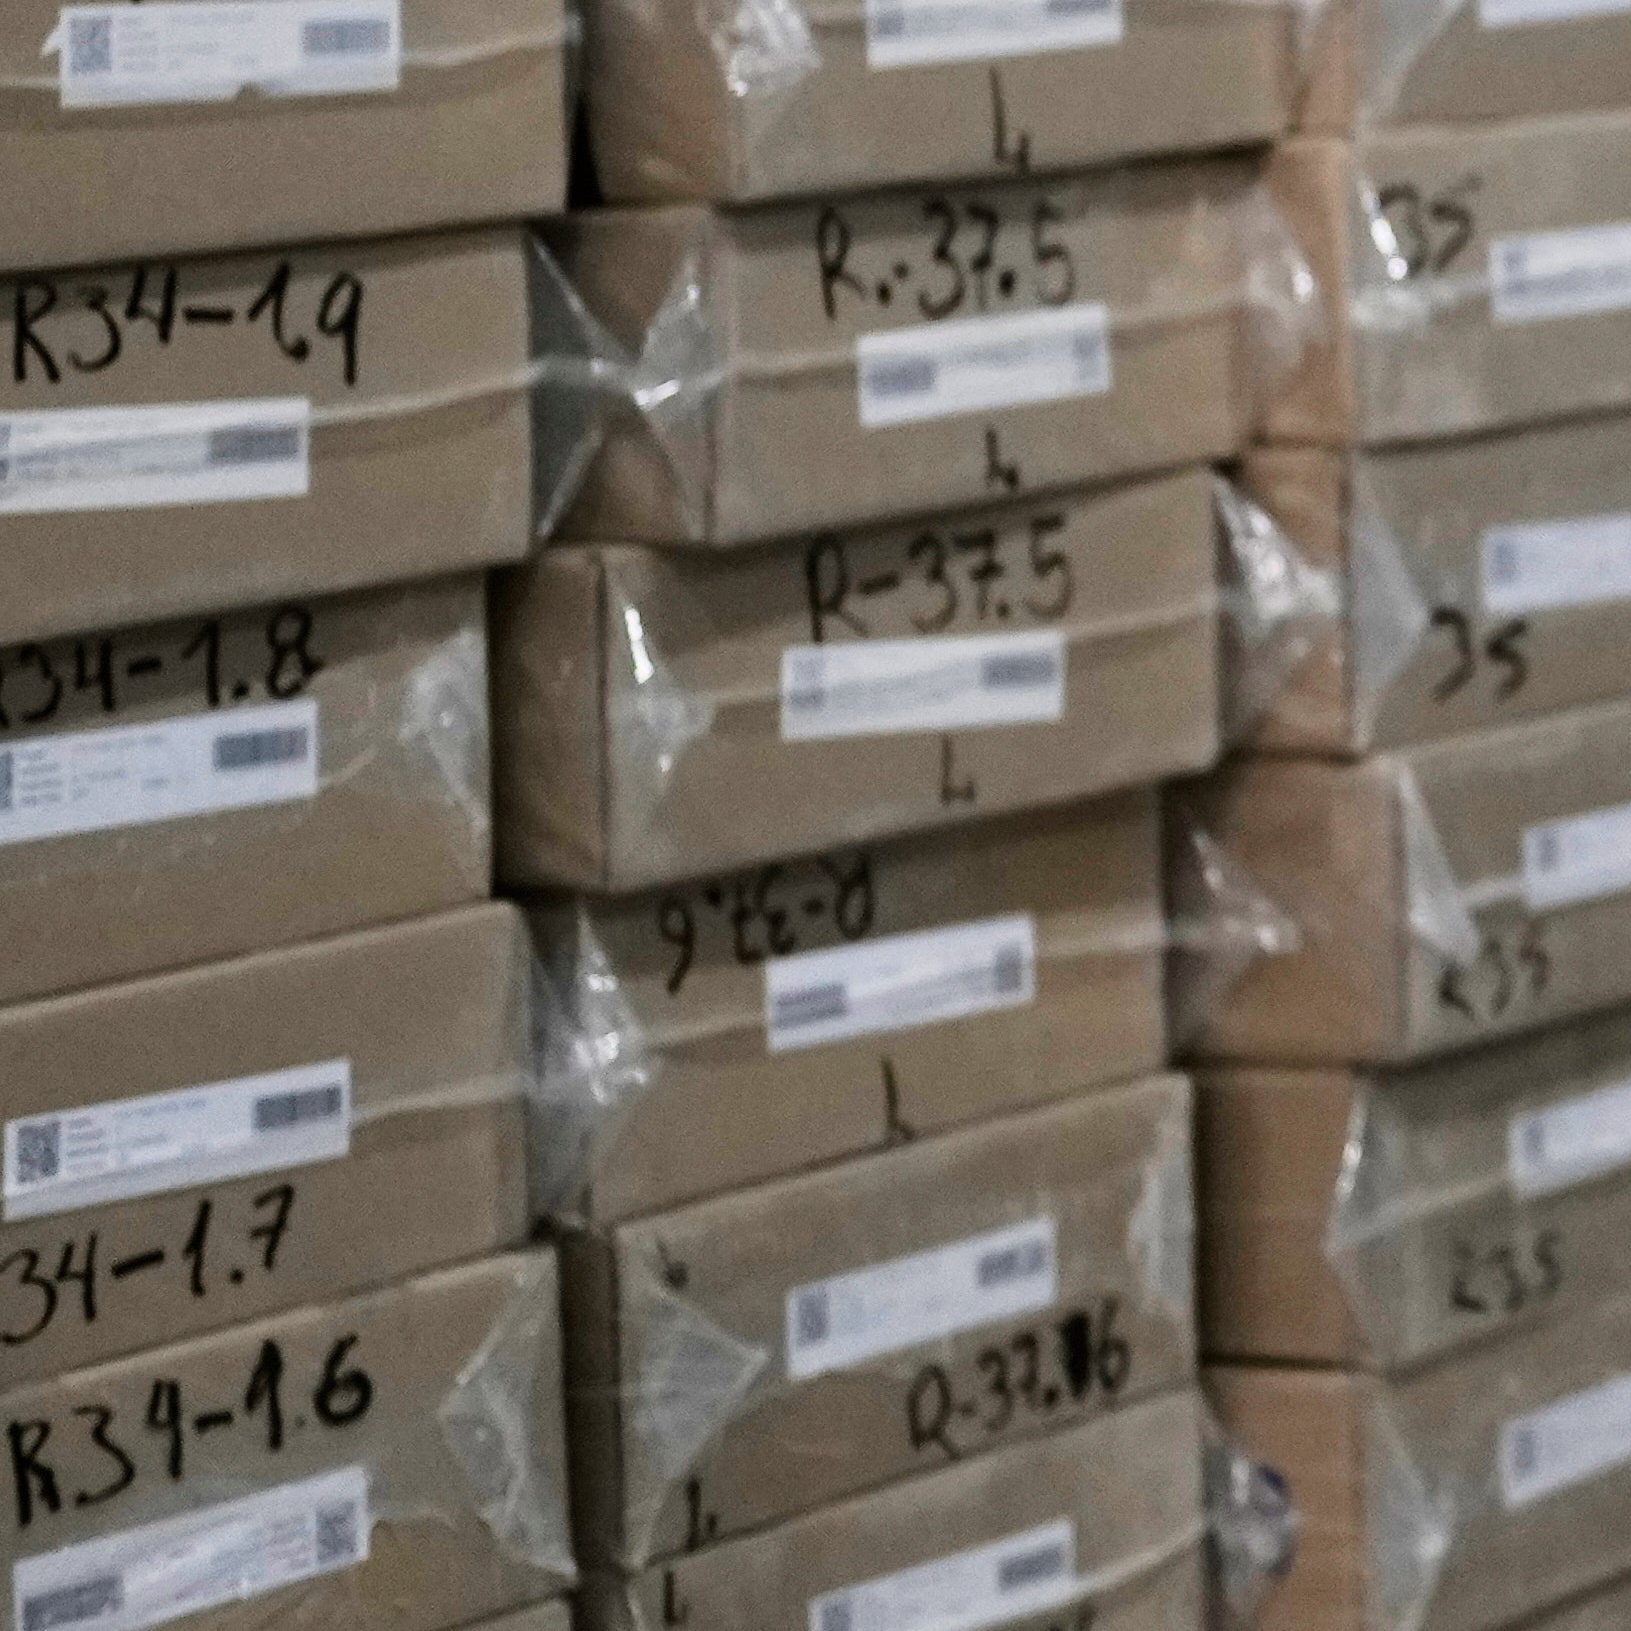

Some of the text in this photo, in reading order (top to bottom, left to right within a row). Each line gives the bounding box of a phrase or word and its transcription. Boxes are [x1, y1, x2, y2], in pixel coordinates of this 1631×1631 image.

[805, 513, 1073, 642] R-37.5
[0, 607, 324, 729] 34-1.8
[0, 1183, 296, 1345] 34-1.7
